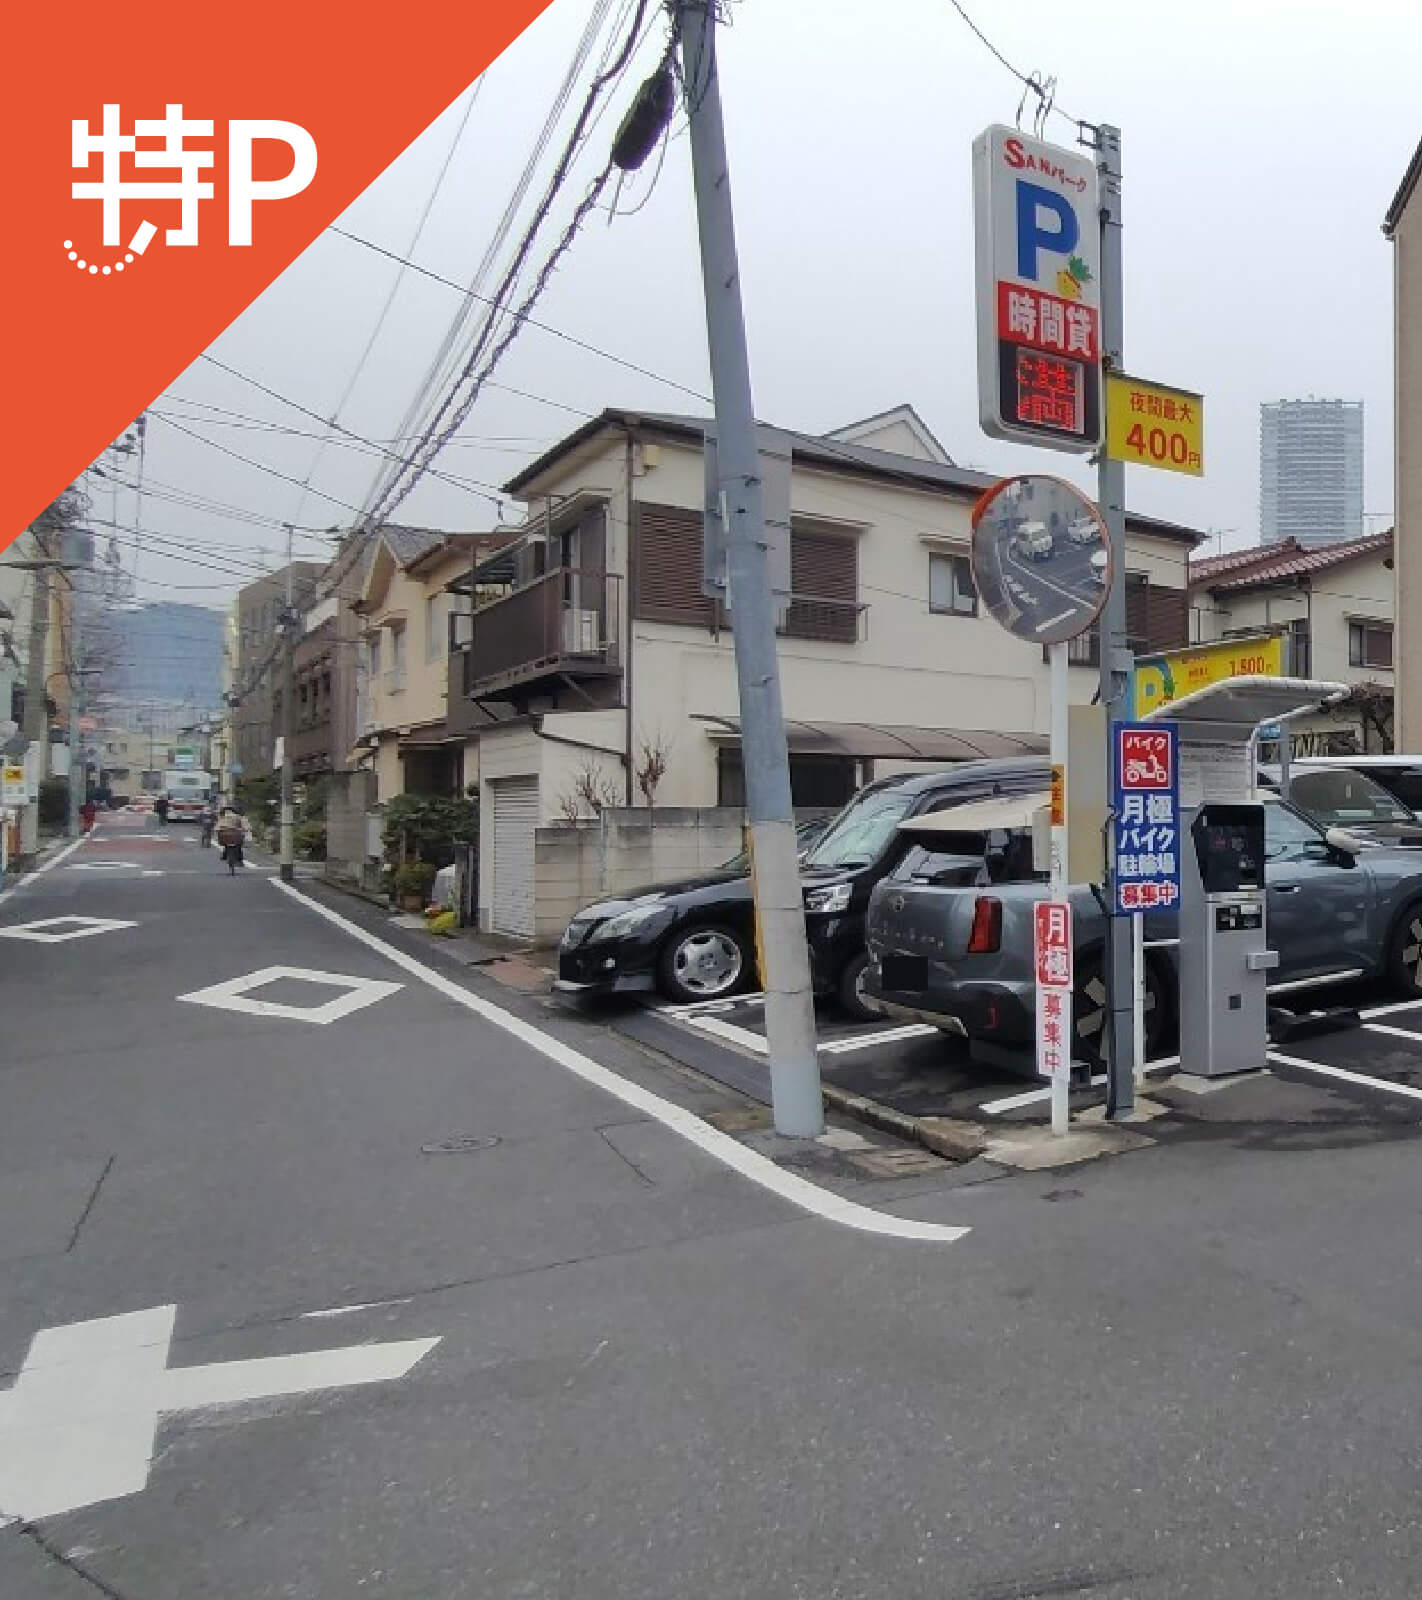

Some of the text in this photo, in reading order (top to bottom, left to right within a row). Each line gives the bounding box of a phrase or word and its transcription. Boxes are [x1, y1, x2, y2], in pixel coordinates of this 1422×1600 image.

[1016, 178, 1080, 281] P
[1008, 291, 1092, 356] 時間貸
[1130, 392, 1194, 424] 夜間最大
[1126, 424, 1200, 468] 400円
[1126, 736, 1167, 750] バイク
[1120, 794, 1174, 824] 月極
[1118, 826, 1176, 851] バイク
[1117, 852, 1176, 877] 駐輪場
[1121, 880, 1179, 909] 募集中
